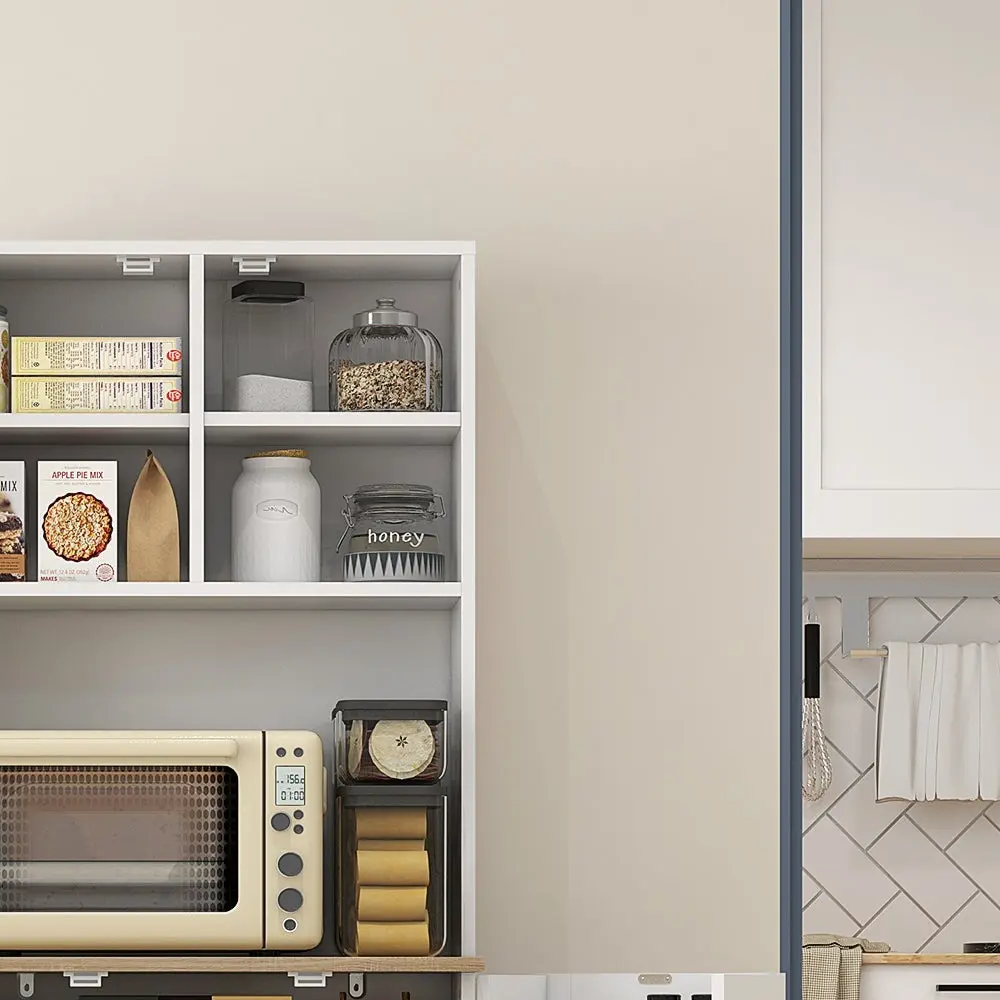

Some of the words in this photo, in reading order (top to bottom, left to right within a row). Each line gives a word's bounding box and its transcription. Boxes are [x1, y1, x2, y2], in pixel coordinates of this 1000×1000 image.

[51, 471, 75, 479] APPLE
[76, 471, 88, 479] PIE
[89, 471, 104, 479] MIX
[0, 480, 18, 492] MIX
[367, 529, 425, 548] honey
